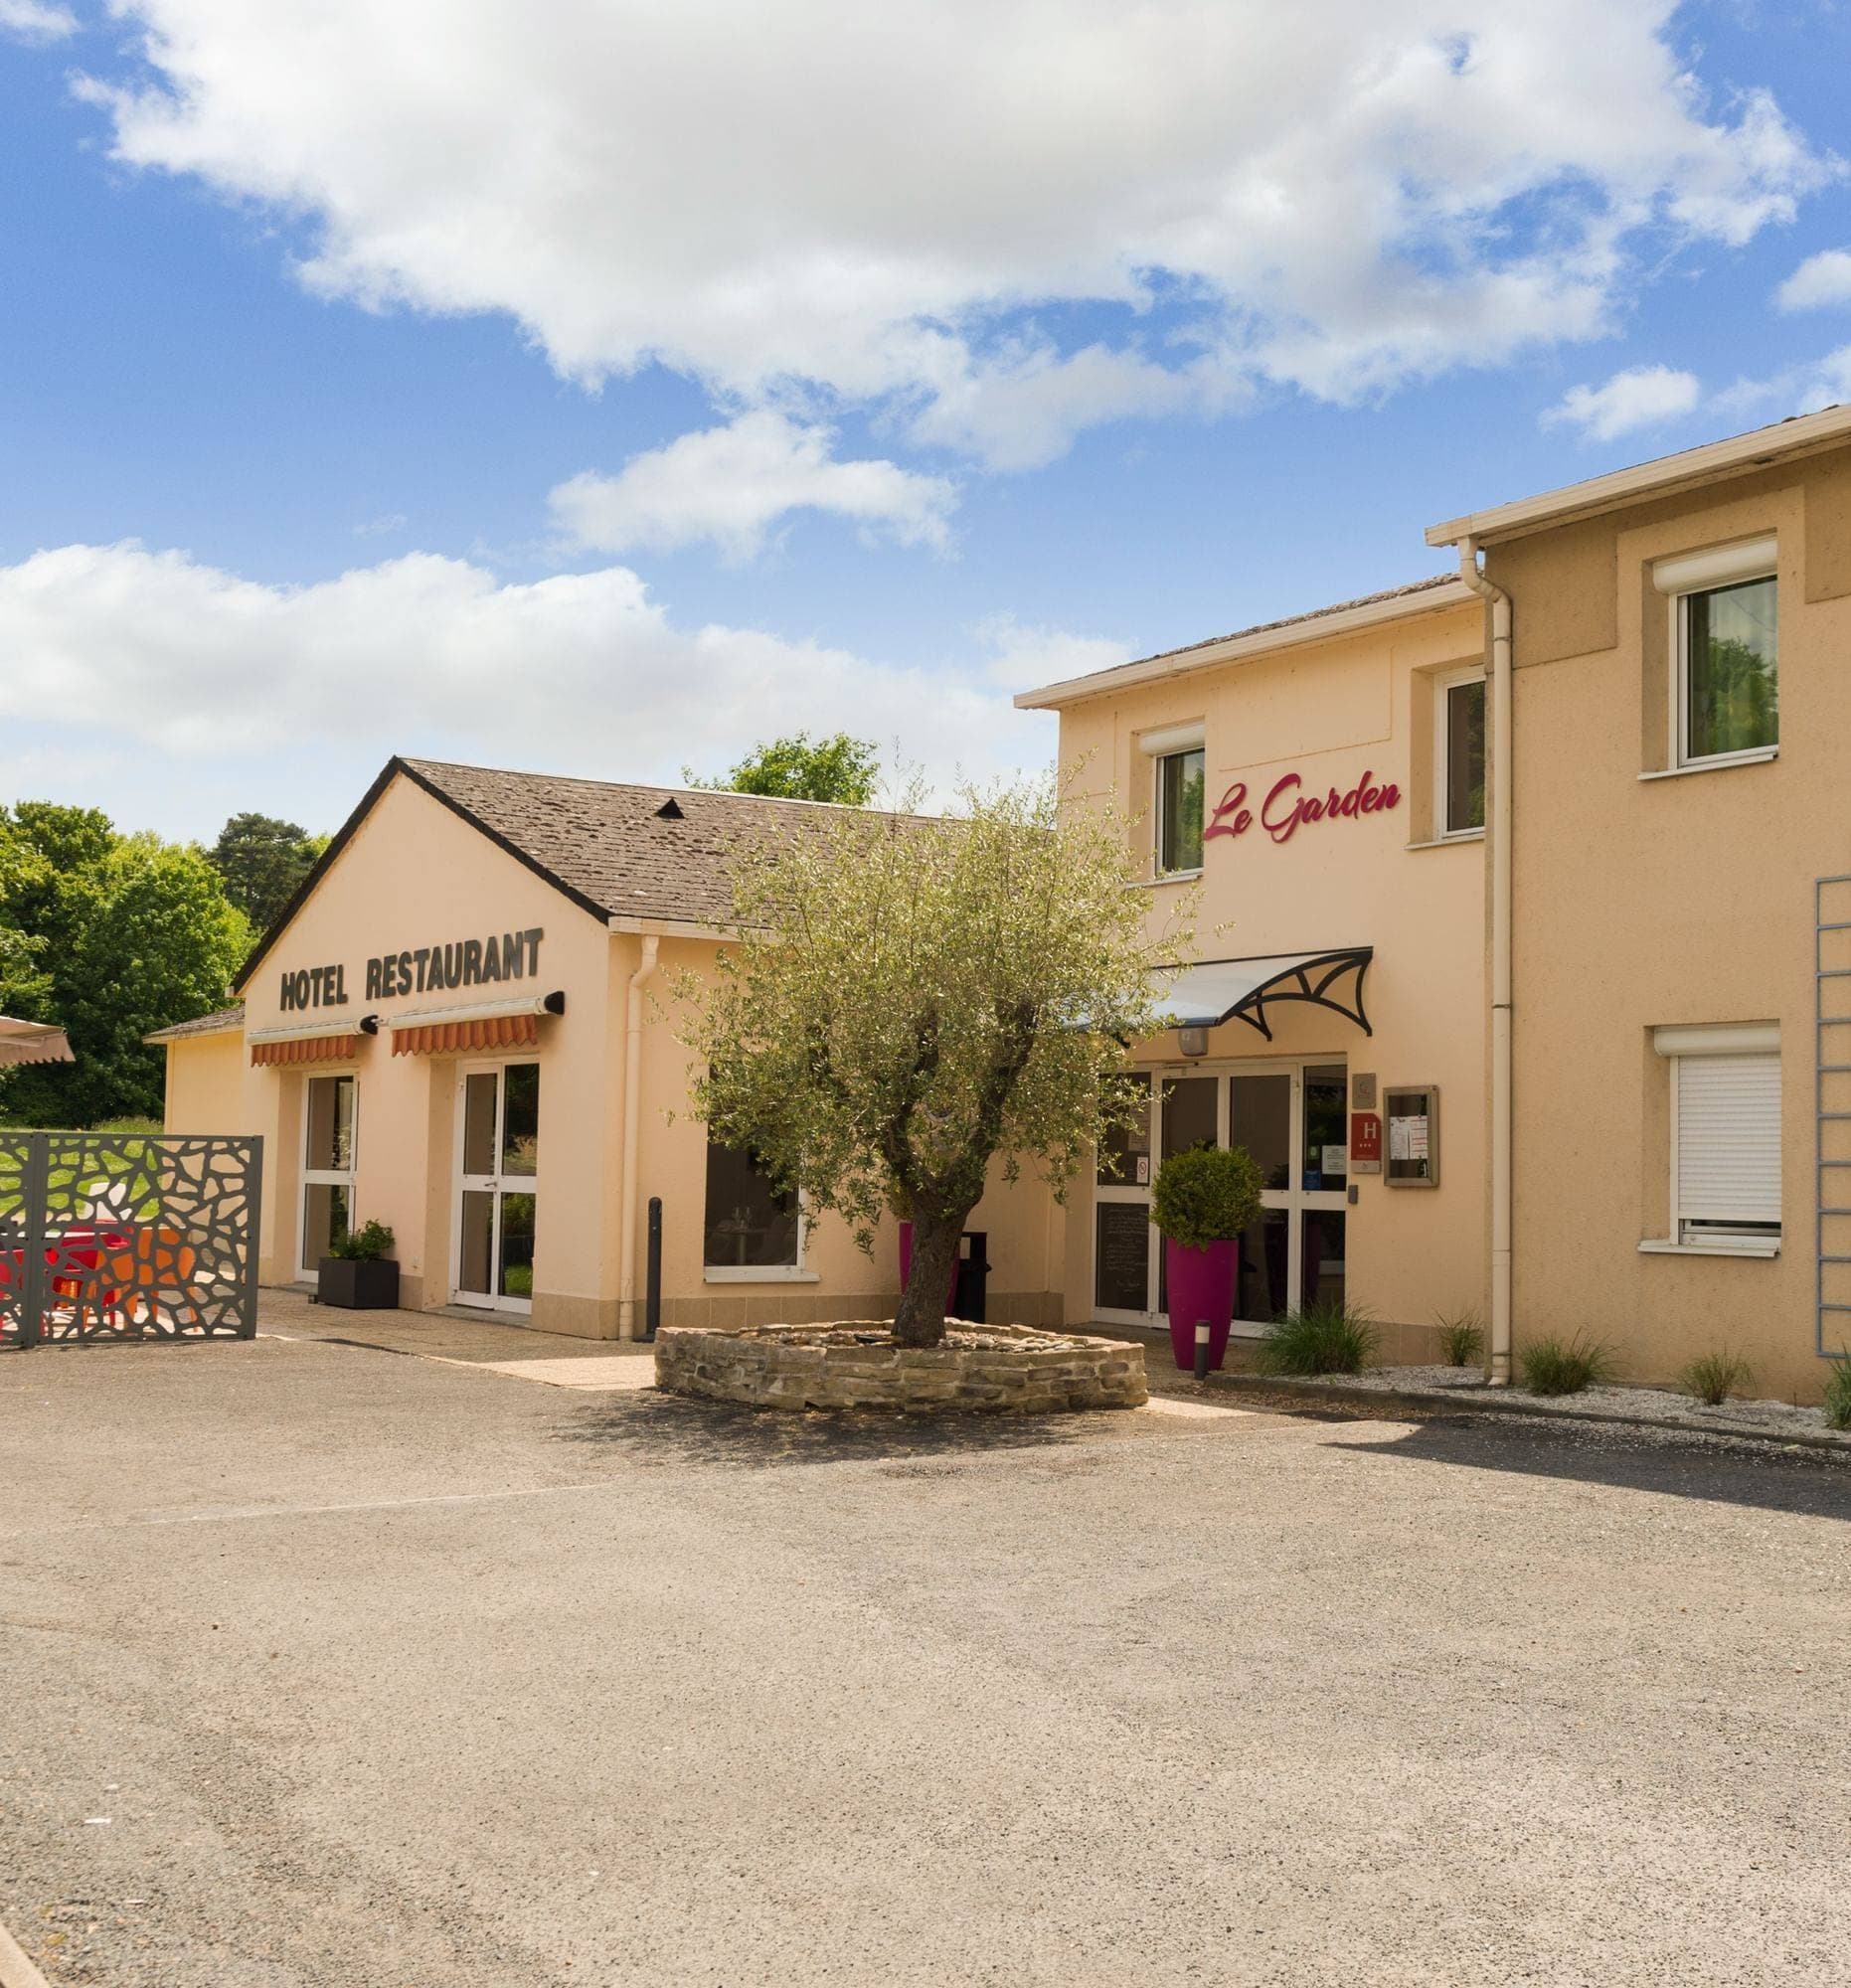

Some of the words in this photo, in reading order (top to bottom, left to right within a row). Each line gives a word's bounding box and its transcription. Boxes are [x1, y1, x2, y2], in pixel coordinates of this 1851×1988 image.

[1203, 782, 1253, 841] Le
[1261, 770, 1402, 844] Garden
[280, 964, 348, 1011] HOTEL
[366, 927, 543, 1000] RESTAURANT
[1364, 1122, 1377, 1140] H
